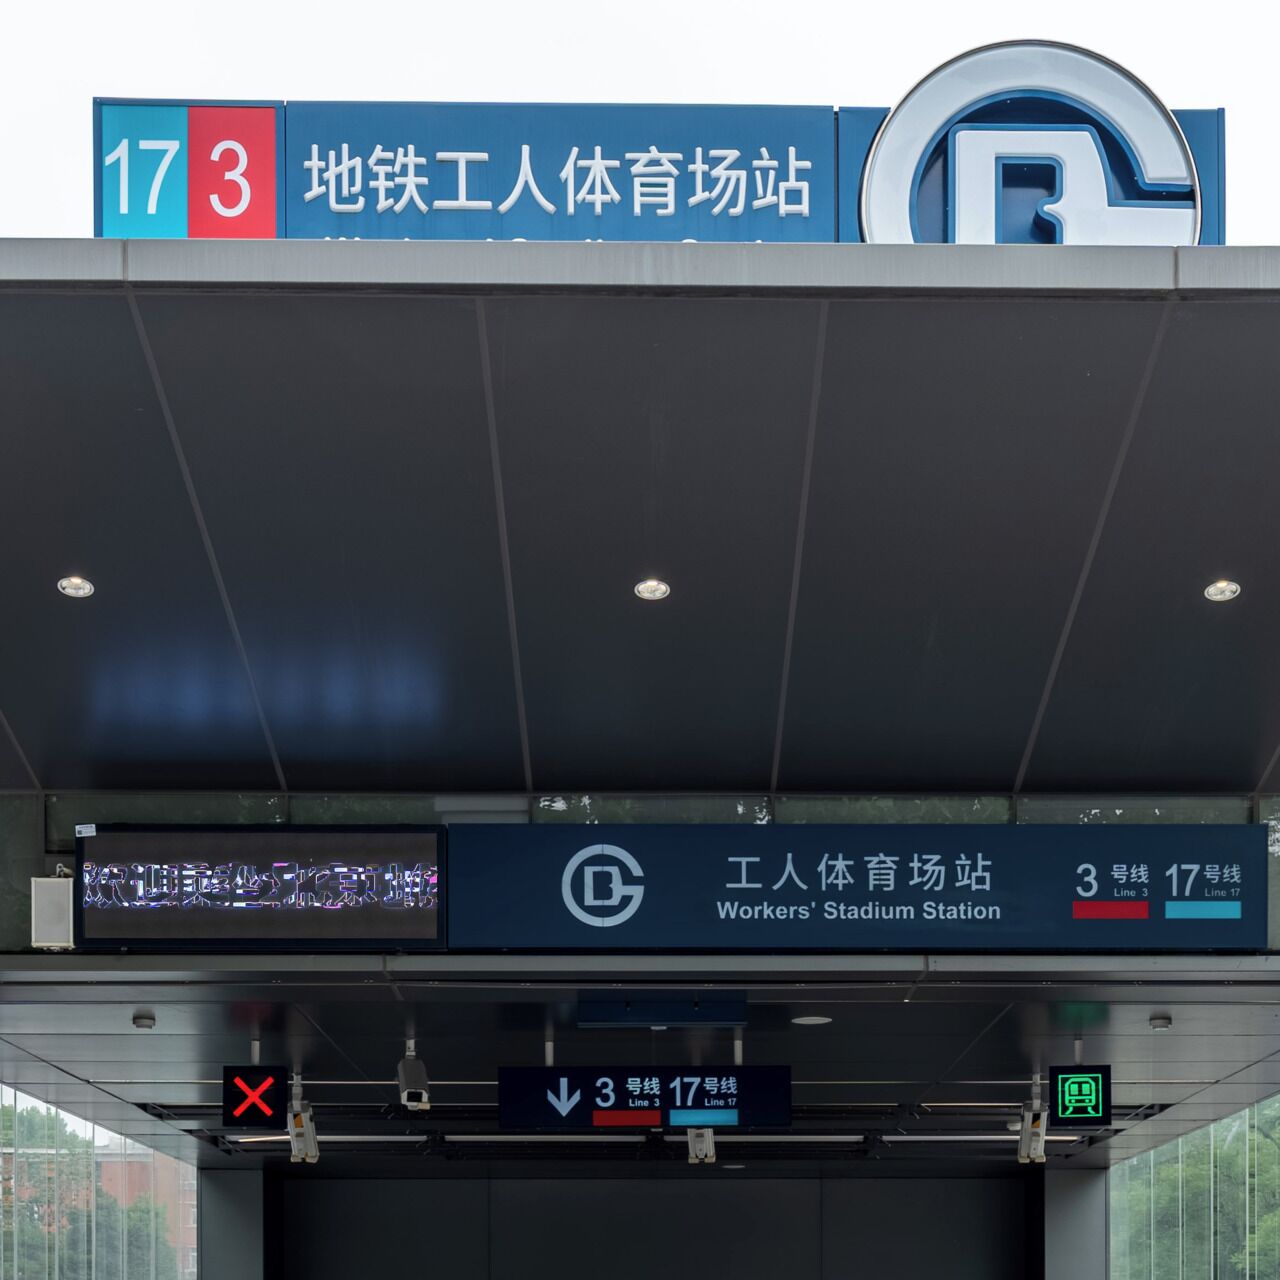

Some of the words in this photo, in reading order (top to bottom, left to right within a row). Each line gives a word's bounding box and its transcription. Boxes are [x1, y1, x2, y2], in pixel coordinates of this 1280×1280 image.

[105, 138, 180, 215] 17
[209, 139, 252, 218] 3
[303, 143, 812, 217] 地铁工人体育场站
[725, 852, 992, 892] 工人体育场站
[1075, 863, 1099, 898] 3
[717, 901, 816, 920] Workers'
[823, 901, 915, 920] Stadium
[922, 901, 1001, 920] Station
[1113, 888, 1136, 897] Line
[1142, 888, 1148, 897] 3
[1204, 888, 1227, 897] Line
[1230, 888, 1241, 897] 17
[595, 1077, 616, 1107] 3
[628, 1098, 649, 1107] Line
[654, 1098, 660, 1107] 3
[704, 1098, 724, 1106] Line
[727, 1098, 737, 1106] 17
